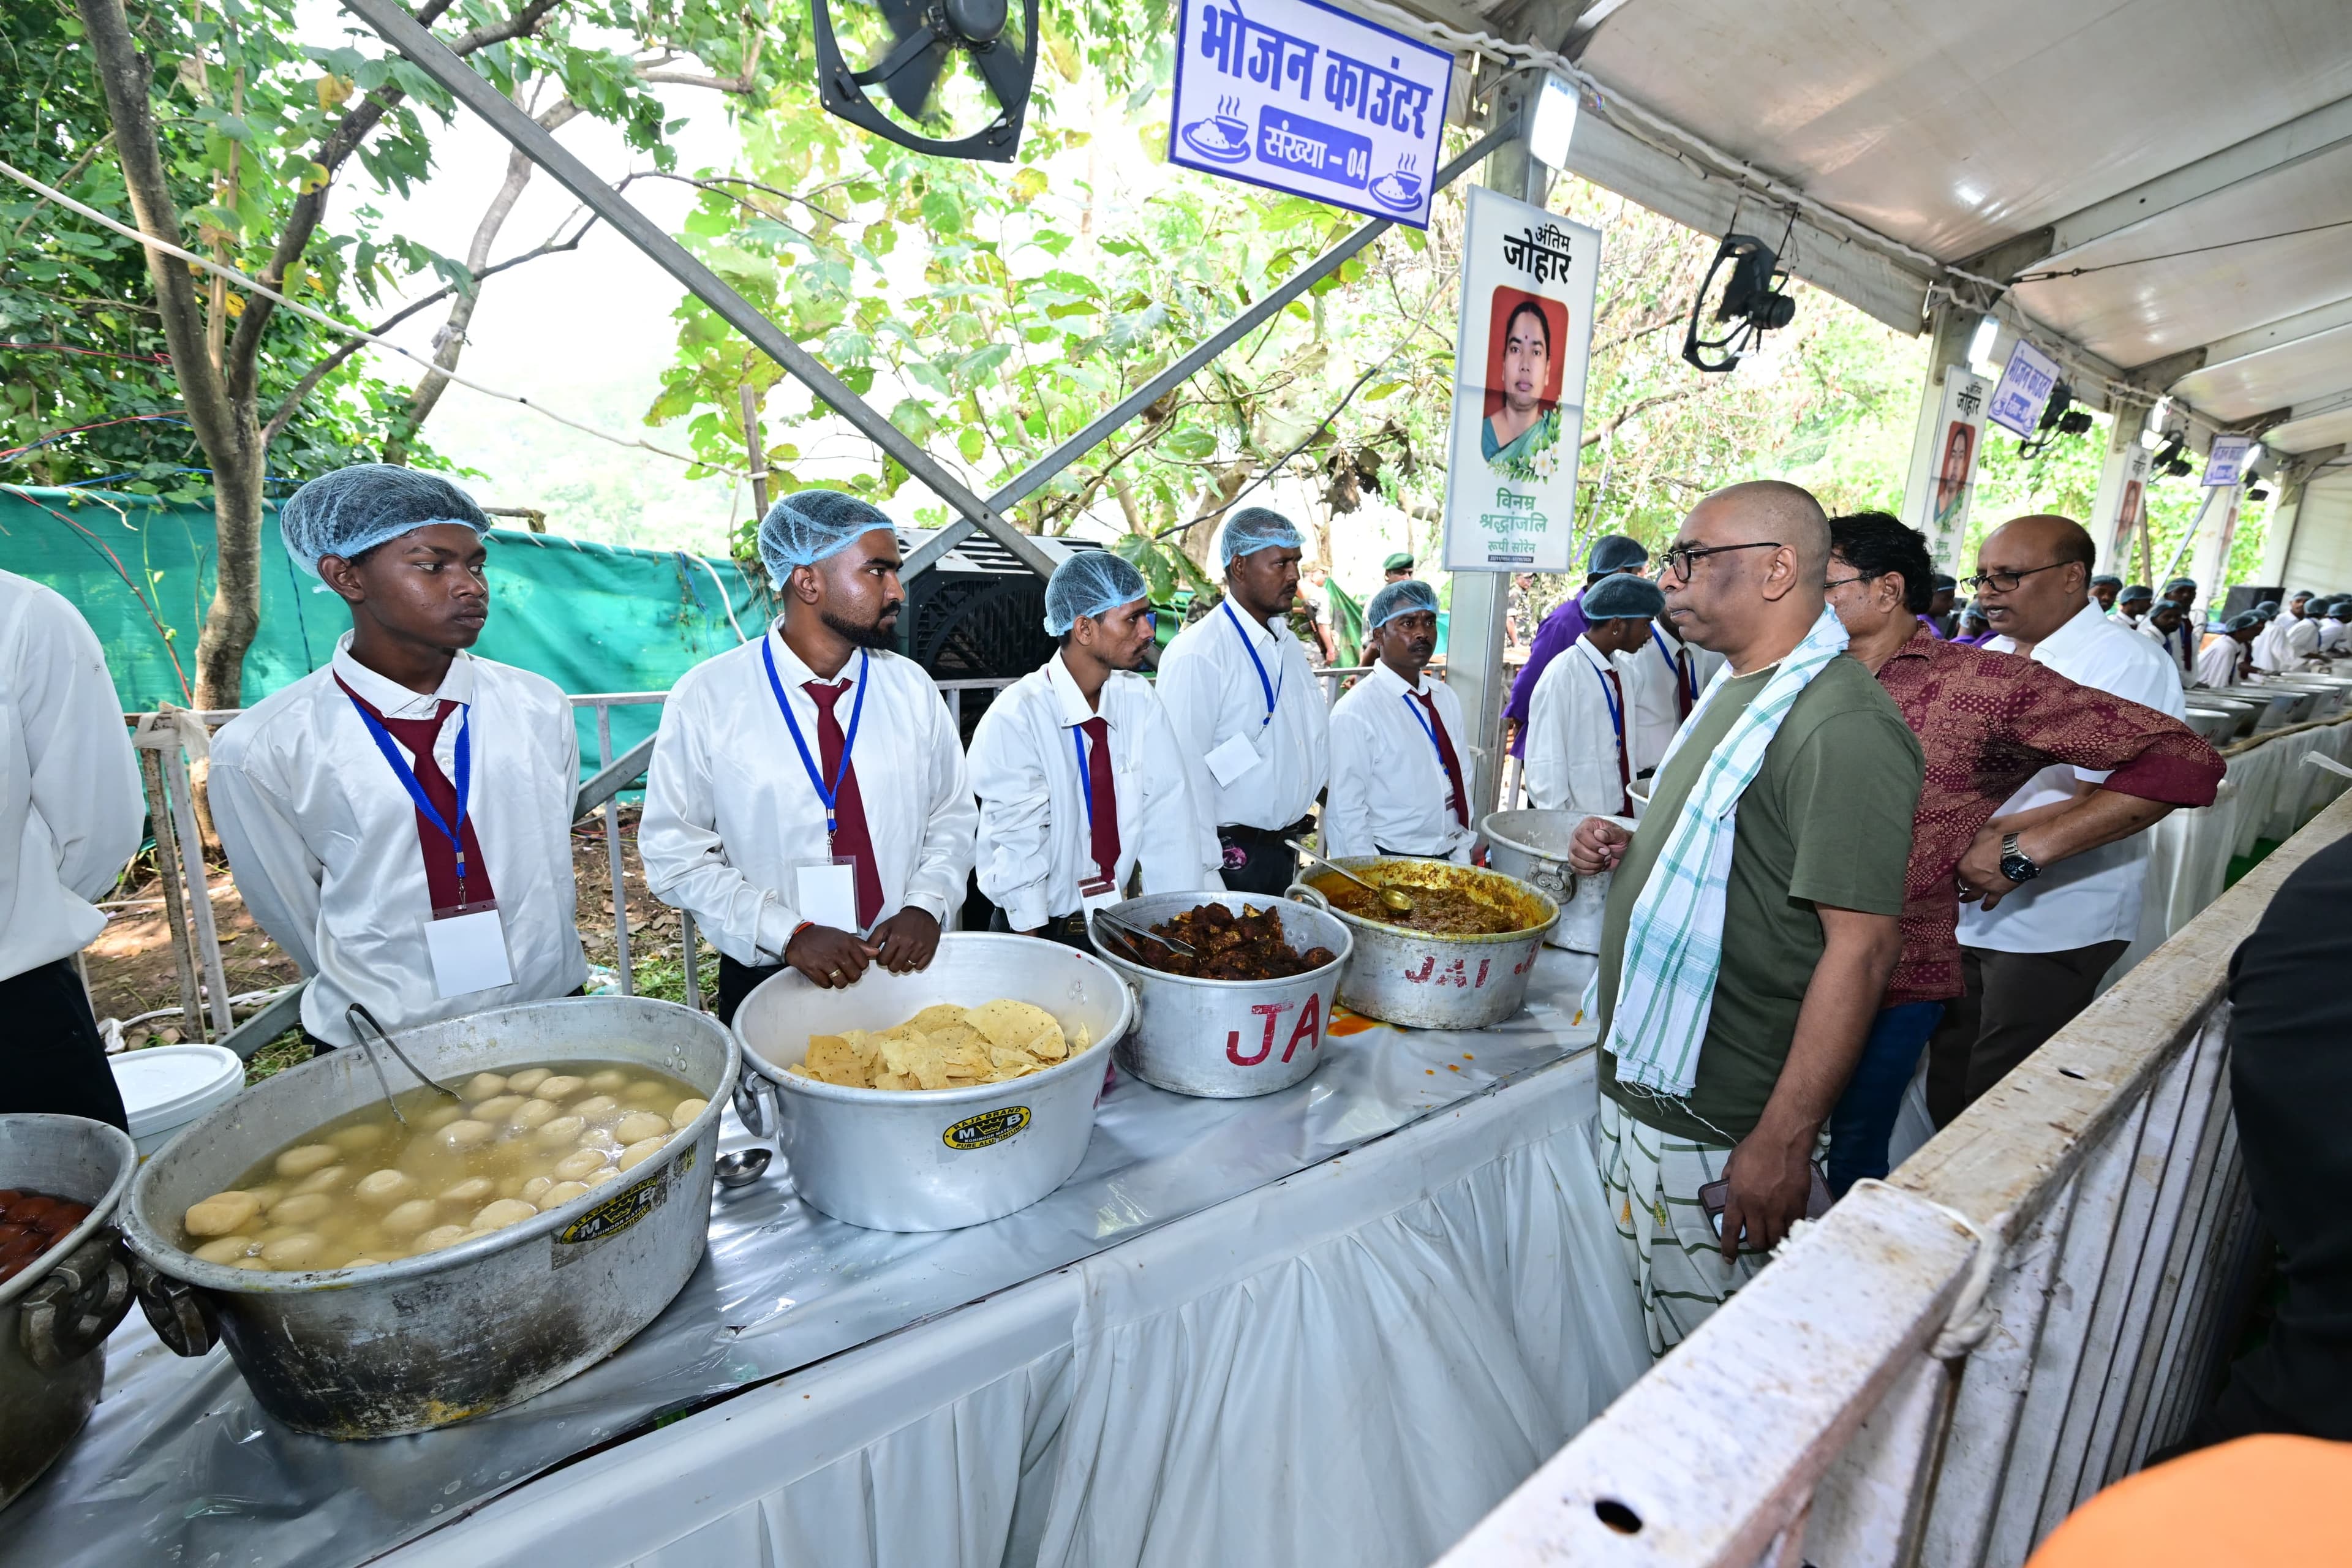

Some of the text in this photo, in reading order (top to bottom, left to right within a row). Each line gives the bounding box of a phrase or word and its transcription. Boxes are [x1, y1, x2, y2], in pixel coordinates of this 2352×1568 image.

[1201, 0, 1433, 140] भोजन काउंटर
[1264, 120, 1327, 170] संख्या
[1535, 223, 1570, 252] अंतिम
[1504, 228, 1572, 284] जोहार
[1496, 488, 1536, 511] विनम्र
[1480, 511, 1548, 533] श्रद्धांजलि
[1488, 538, 1536, 554] रूपी सोरेन
[1405, 956, 1490, 989] JAI
[953, 1107, 1021, 1130] RAJA BRAND
[959, 1114, 1021, 1139] M B
[979, 1125, 1022, 1147] ALUINIUM
